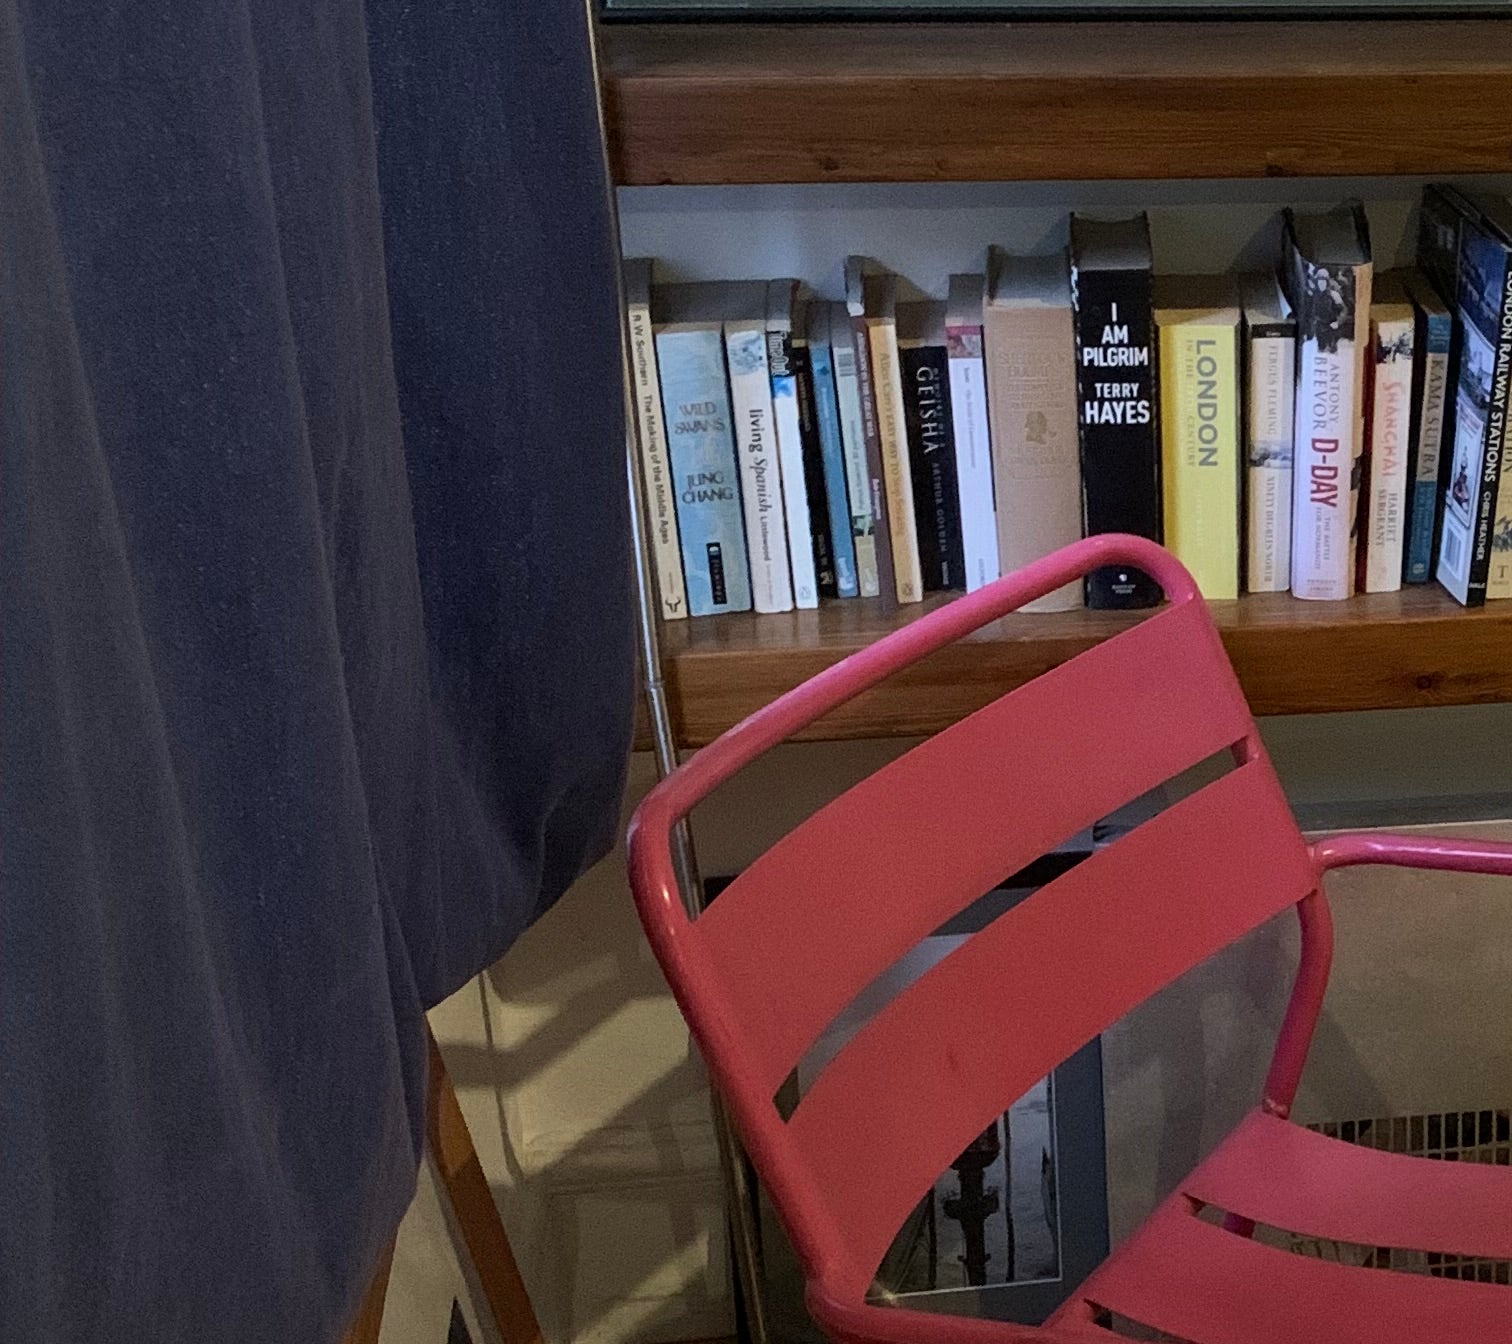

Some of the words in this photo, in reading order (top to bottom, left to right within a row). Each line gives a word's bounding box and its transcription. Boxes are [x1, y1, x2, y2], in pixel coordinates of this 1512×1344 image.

[1111, 301, 1118, 323] I
[1101, 324, 1129, 345] AM
[1185, 340, 1194, 352] IN
[638, 339, 650, 387] Southern
[879, 352, 893, 381] Allen
[1082, 345, 1150, 367] PILGRIM
[1184, 357, 1194, 380] THE
[1267, 346, 1279, 385] FERGUS
[1094, 382, 1140, 399] TERRY
[1426, 358, 1445, 413] KAMA
[1491, 343, 1512, 408] RAILWAY
[644, 394, 654, 414] The
[680, 401, 718, 417] WILD
[915, 366, 941, 456] GEISHA
[1083, 399, 1151, 425] HAYES
[1195, 339, 1219, 468] LONDON
[1312, 357, 1329, 432] BEEVOR
[1327, 364, 1342, 424] ANTONY
[674, 417, 725, 435] SWANS
[885, 414, 896, 438] EASY
[1267, 389, 1279, 436] FLEMING
[1381, 381, 1400, 477] SHANGHAI
[645, 415, 658, 453] Making
[748, 408, 765, 454] living
[887, 439, 898, 459] WAY
[1186, 414, 1197, 468] CENTURY
[1420, 416, 1441, 477] SUTRA
[1483, 411, 1507, 483] STATIONS
[650, 454, 661, 465] of
[653, 466, 664, 483] the
[891, 462, 901, 476] TO
[1309, 437, 1341, 509] D-DAY
[656, 484, 668, 519] Middle
[749, 456, 773, 513] Spanish
[931, 462, 944, 505] ARTHUR
[1375, 488, 1388, 548] SERGEANT
[1386, 493, 1399, 543] HARRIET
[1480, 491, 1493, 519] CHRIS
[660, 519, 671, 545] Ages
[1323, 517, 1332, 532] THE
[1474, 519, 1488, 562] HEATHER
[1263, 553, 1276, 583] NORTH
